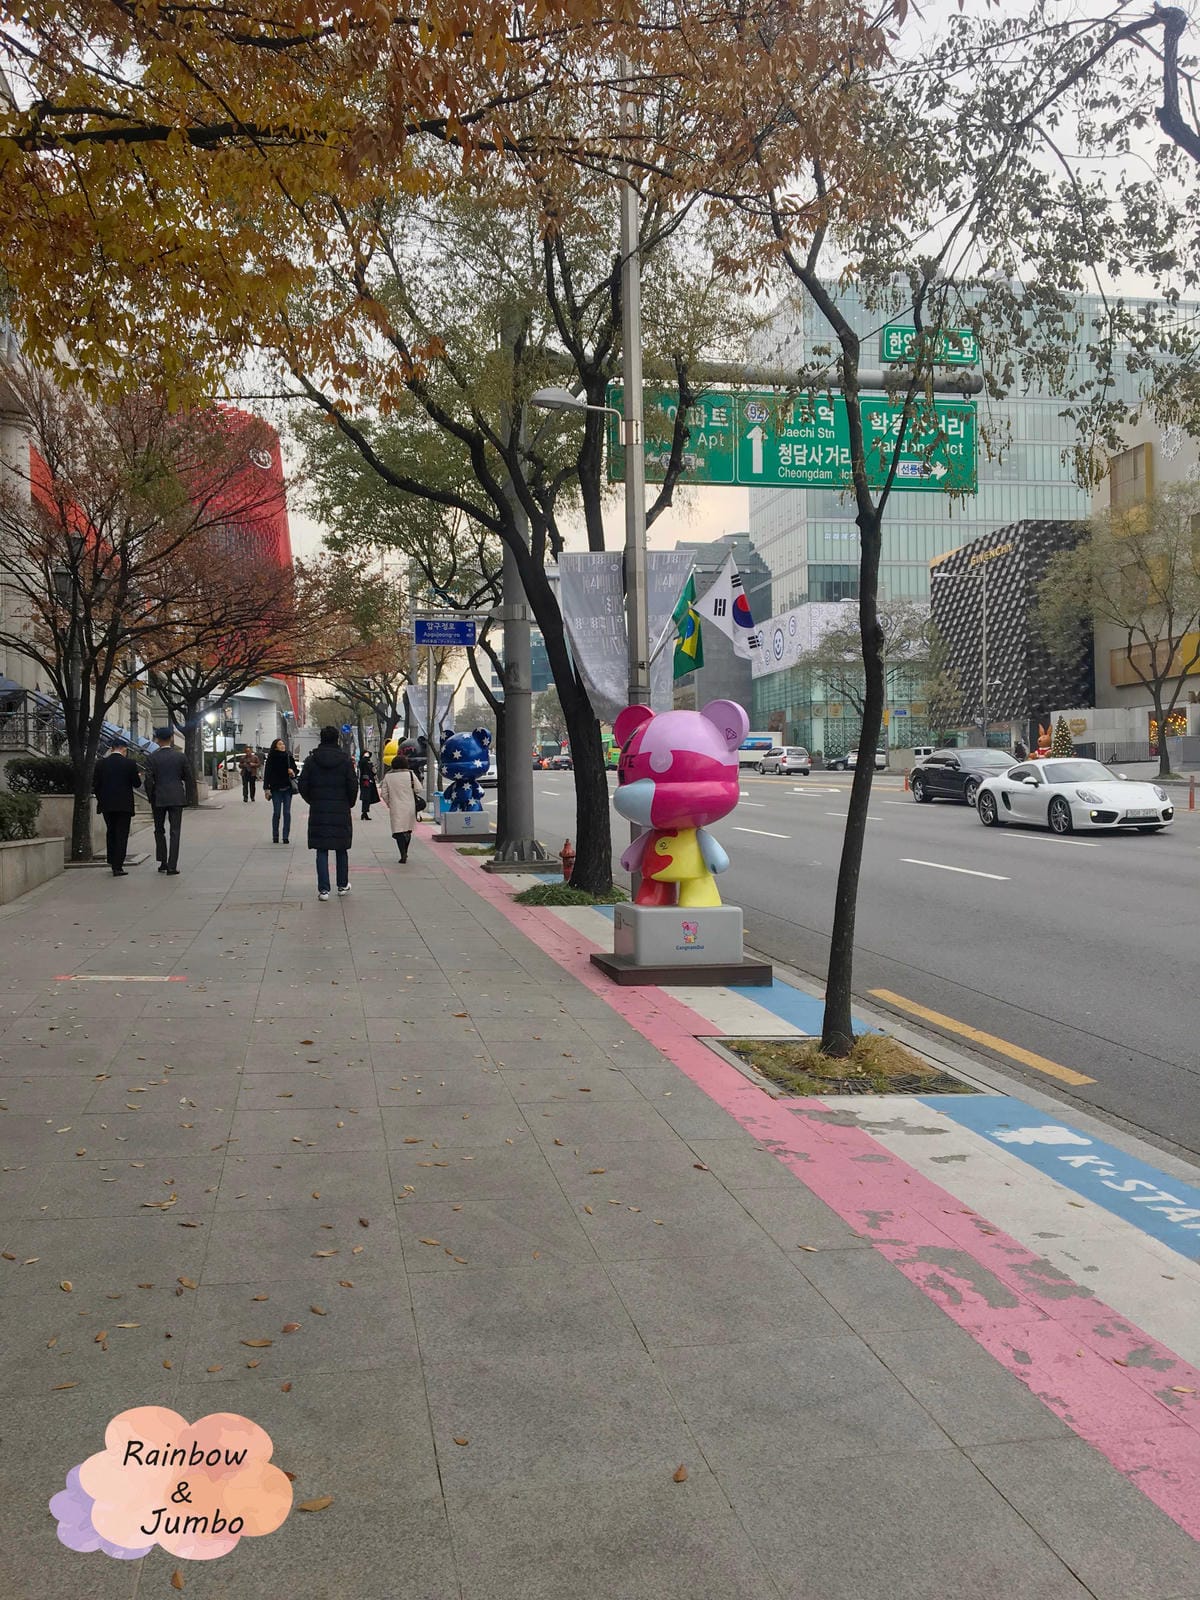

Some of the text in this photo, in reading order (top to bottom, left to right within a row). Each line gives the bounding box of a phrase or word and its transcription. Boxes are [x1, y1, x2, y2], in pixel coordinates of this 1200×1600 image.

[697, 432, 725, 449] Apt
[817, 427, 835, 439] Stn
[778, 466, 833, 481] Cheongdam
